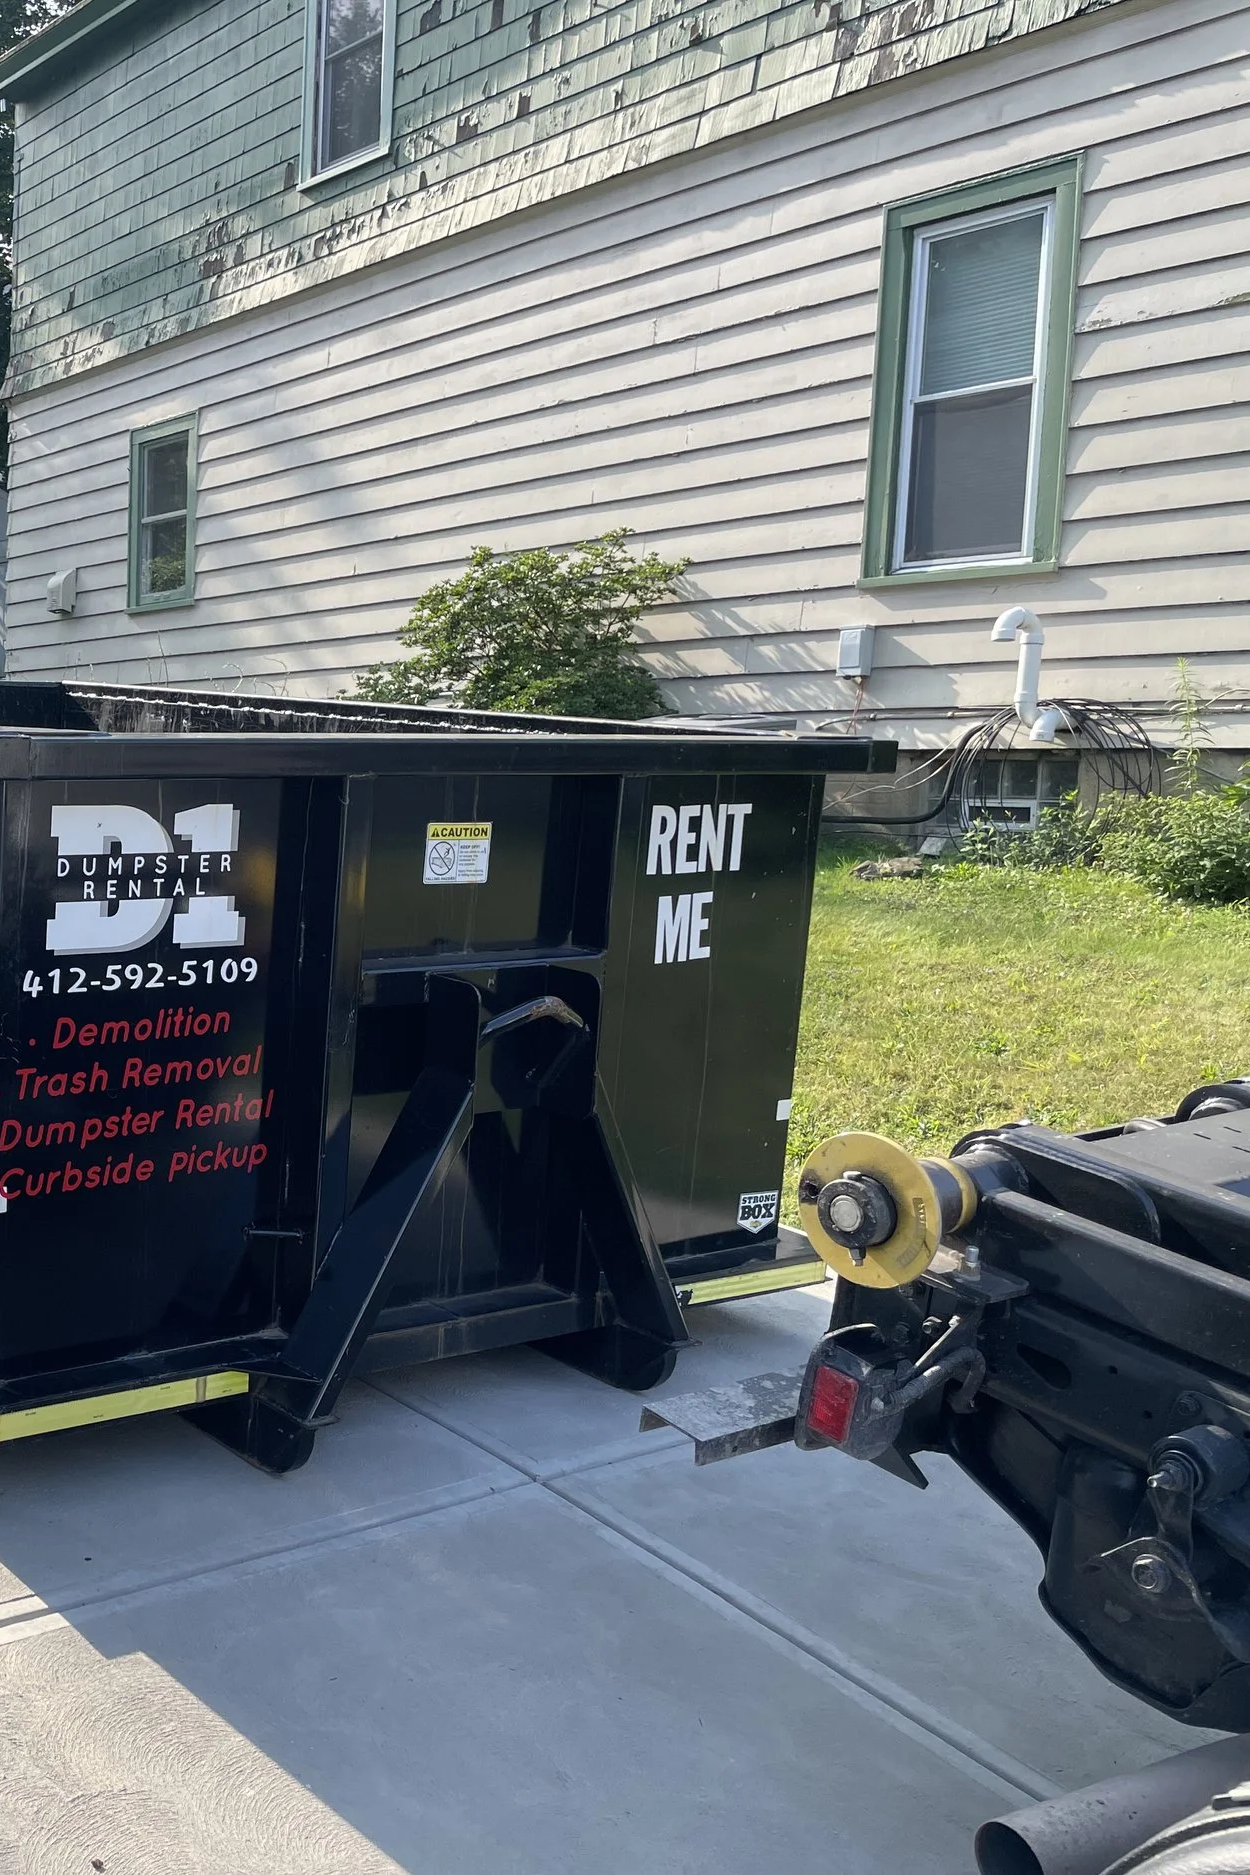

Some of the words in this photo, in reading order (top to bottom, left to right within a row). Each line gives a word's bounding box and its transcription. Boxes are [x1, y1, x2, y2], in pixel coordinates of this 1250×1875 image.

[440, 827, 489, 838] CAUTION
[646, 803, 753, 876] RENT
[57, 853, 232, 878] DUMPSTER
[83, 878, 206, 900] RENTAL
[654, 891, 714, 965] ME
[22, 957, 259, 998] 412-592-5109
[52, 1006, 231, 1050] Demolition
[15, 1061, 109, 1101] Trash
[122, 1045, 263, 1089] Removal
[175, 1089, 275, 1131] Rental
[740, 1203, 775, 1220] BOX
[742, 1194, 776, 1204] STRONG
